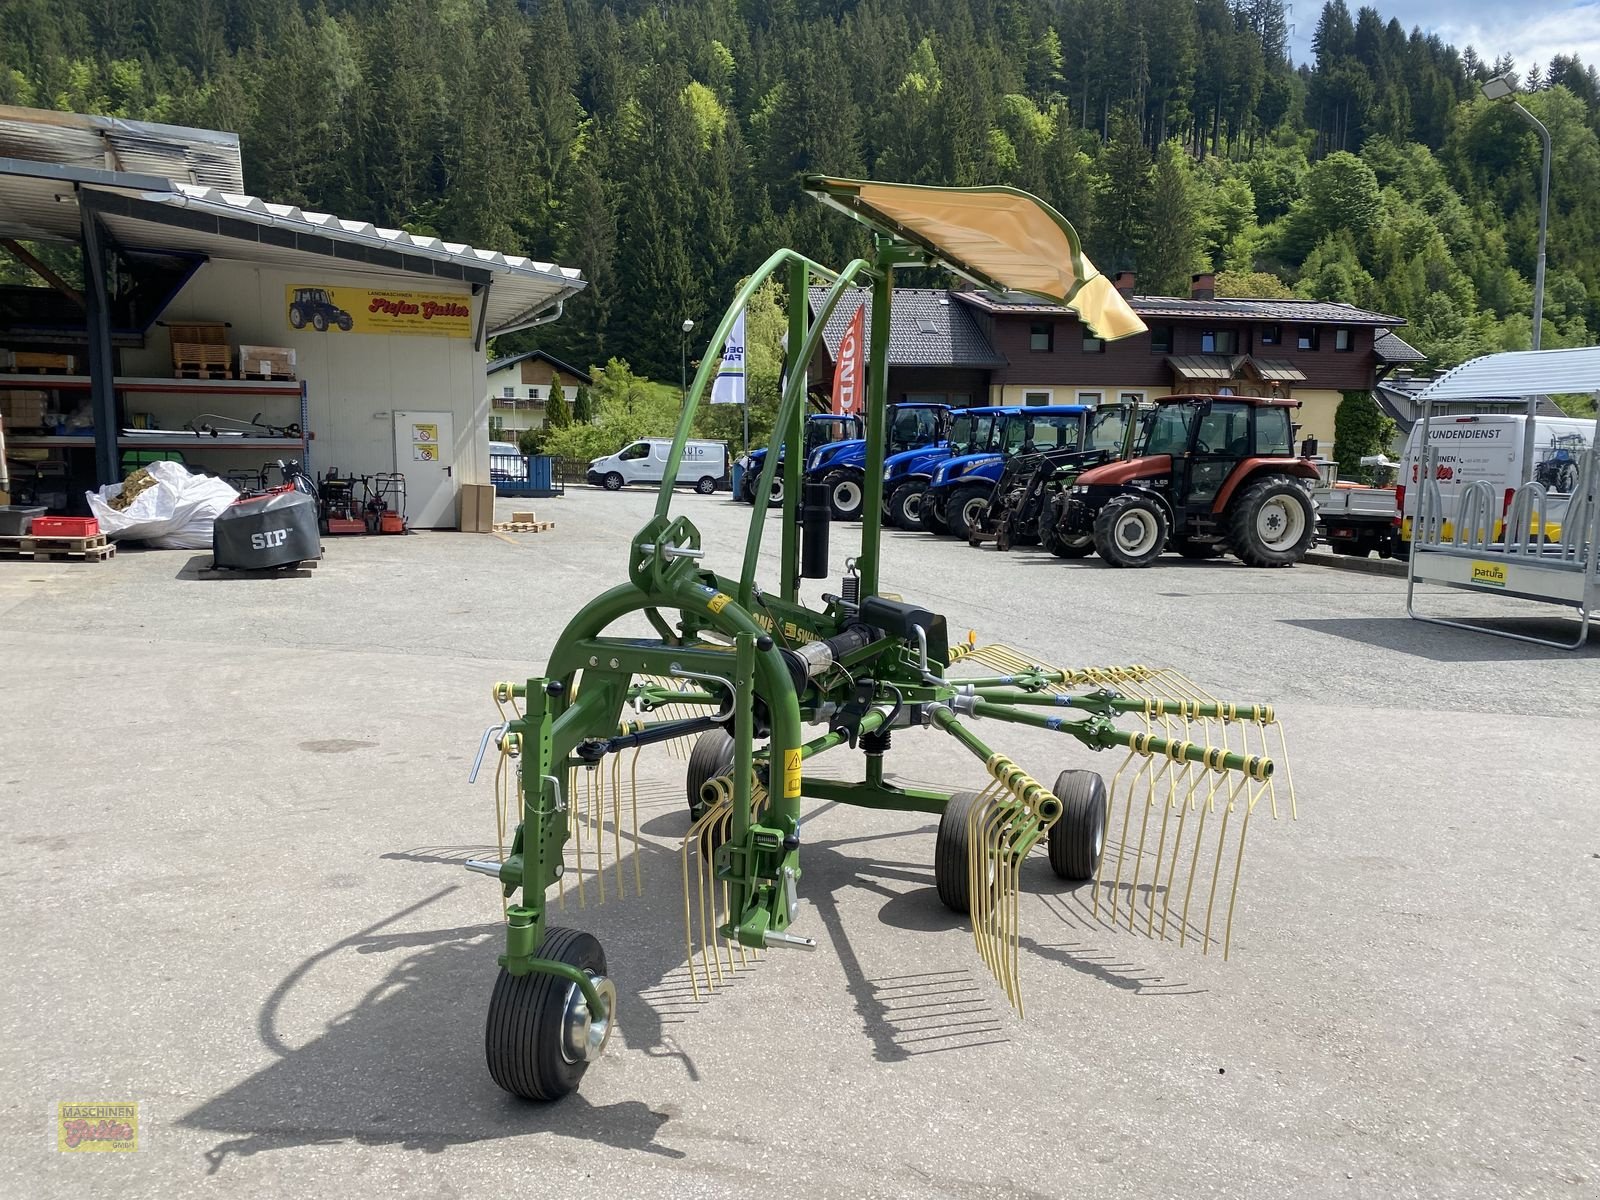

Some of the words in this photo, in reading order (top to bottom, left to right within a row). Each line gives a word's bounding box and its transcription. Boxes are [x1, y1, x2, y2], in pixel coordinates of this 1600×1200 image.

[1427, 429, 1502, 439] KUNDENDIENST
[251, 529, 287, 550] SIP
[1474, 567, 1504, 579] patura
